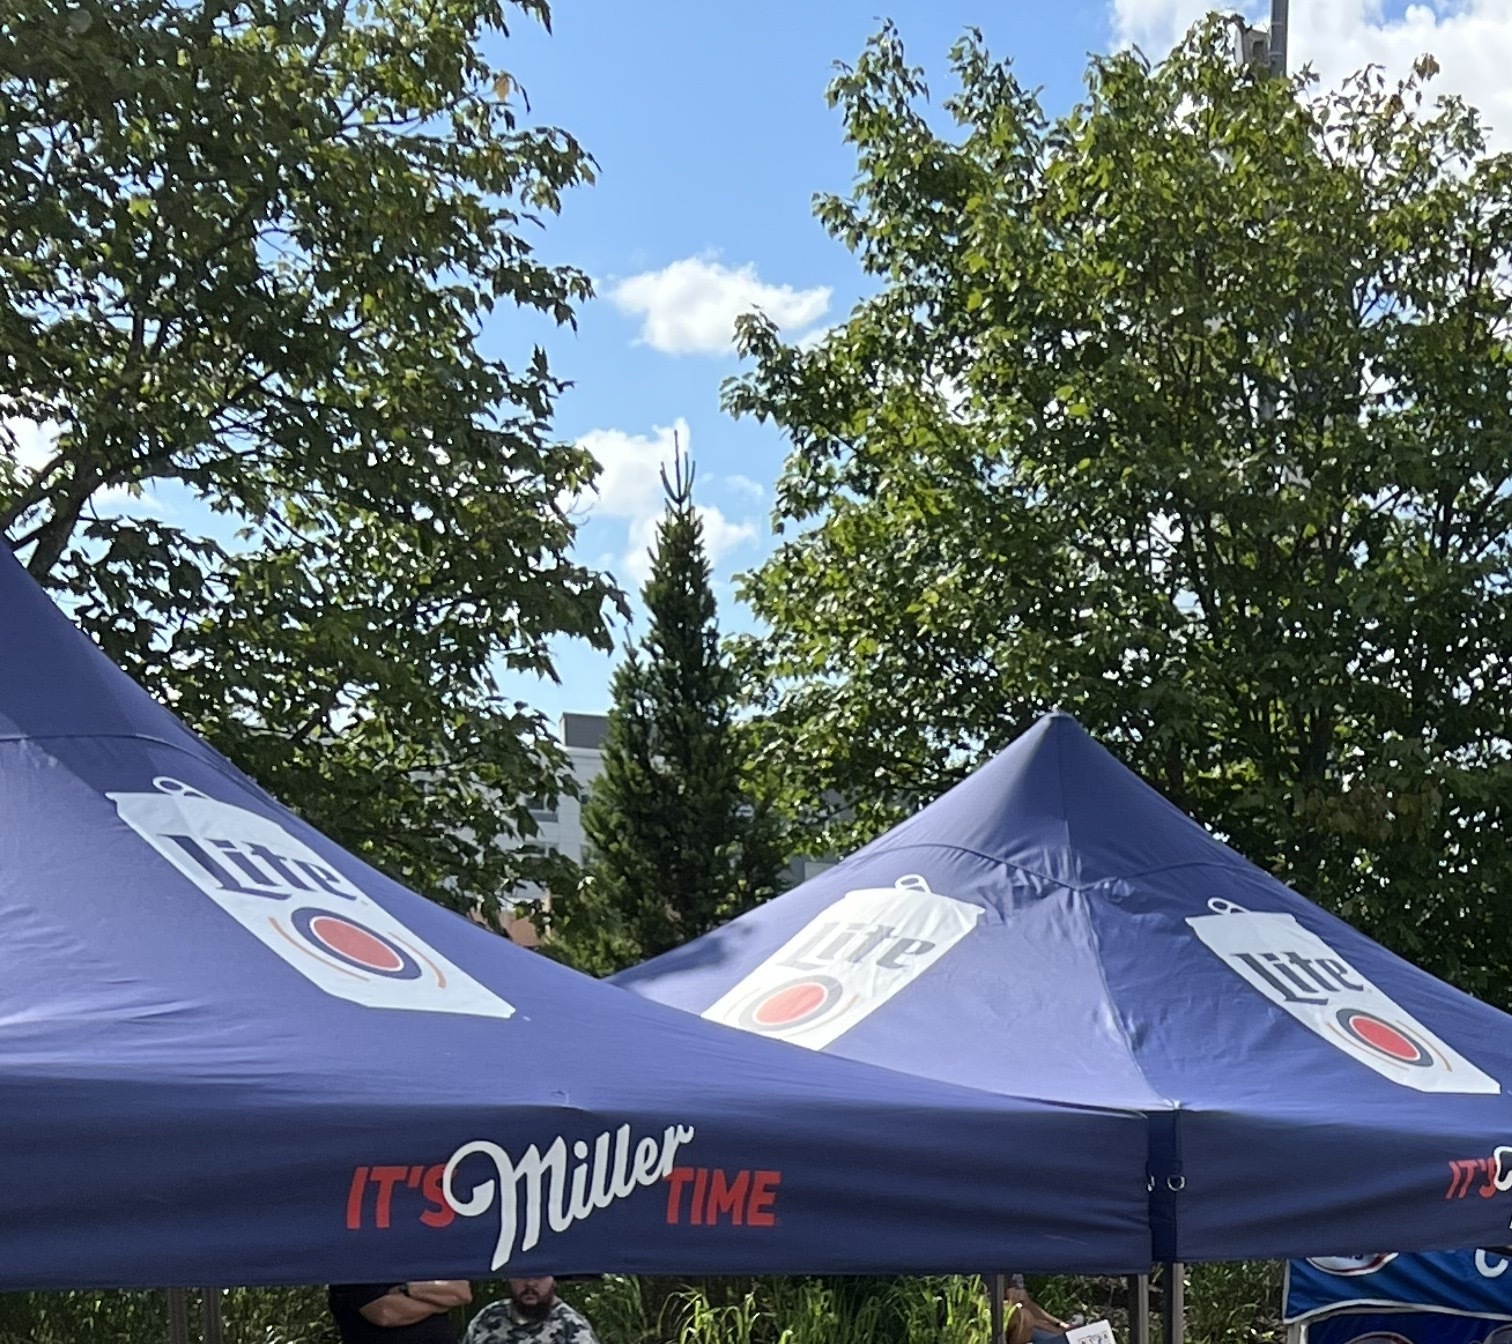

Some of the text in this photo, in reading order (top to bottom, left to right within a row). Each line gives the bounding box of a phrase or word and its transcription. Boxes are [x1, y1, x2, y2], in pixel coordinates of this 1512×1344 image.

[156, 832, 358, 901] Lite
[777, 920, 935, 971] Lite
[1231, 951, 1364, 1005] Lite
[346, 1123, 782, 1271] IT'S Miller TIME
